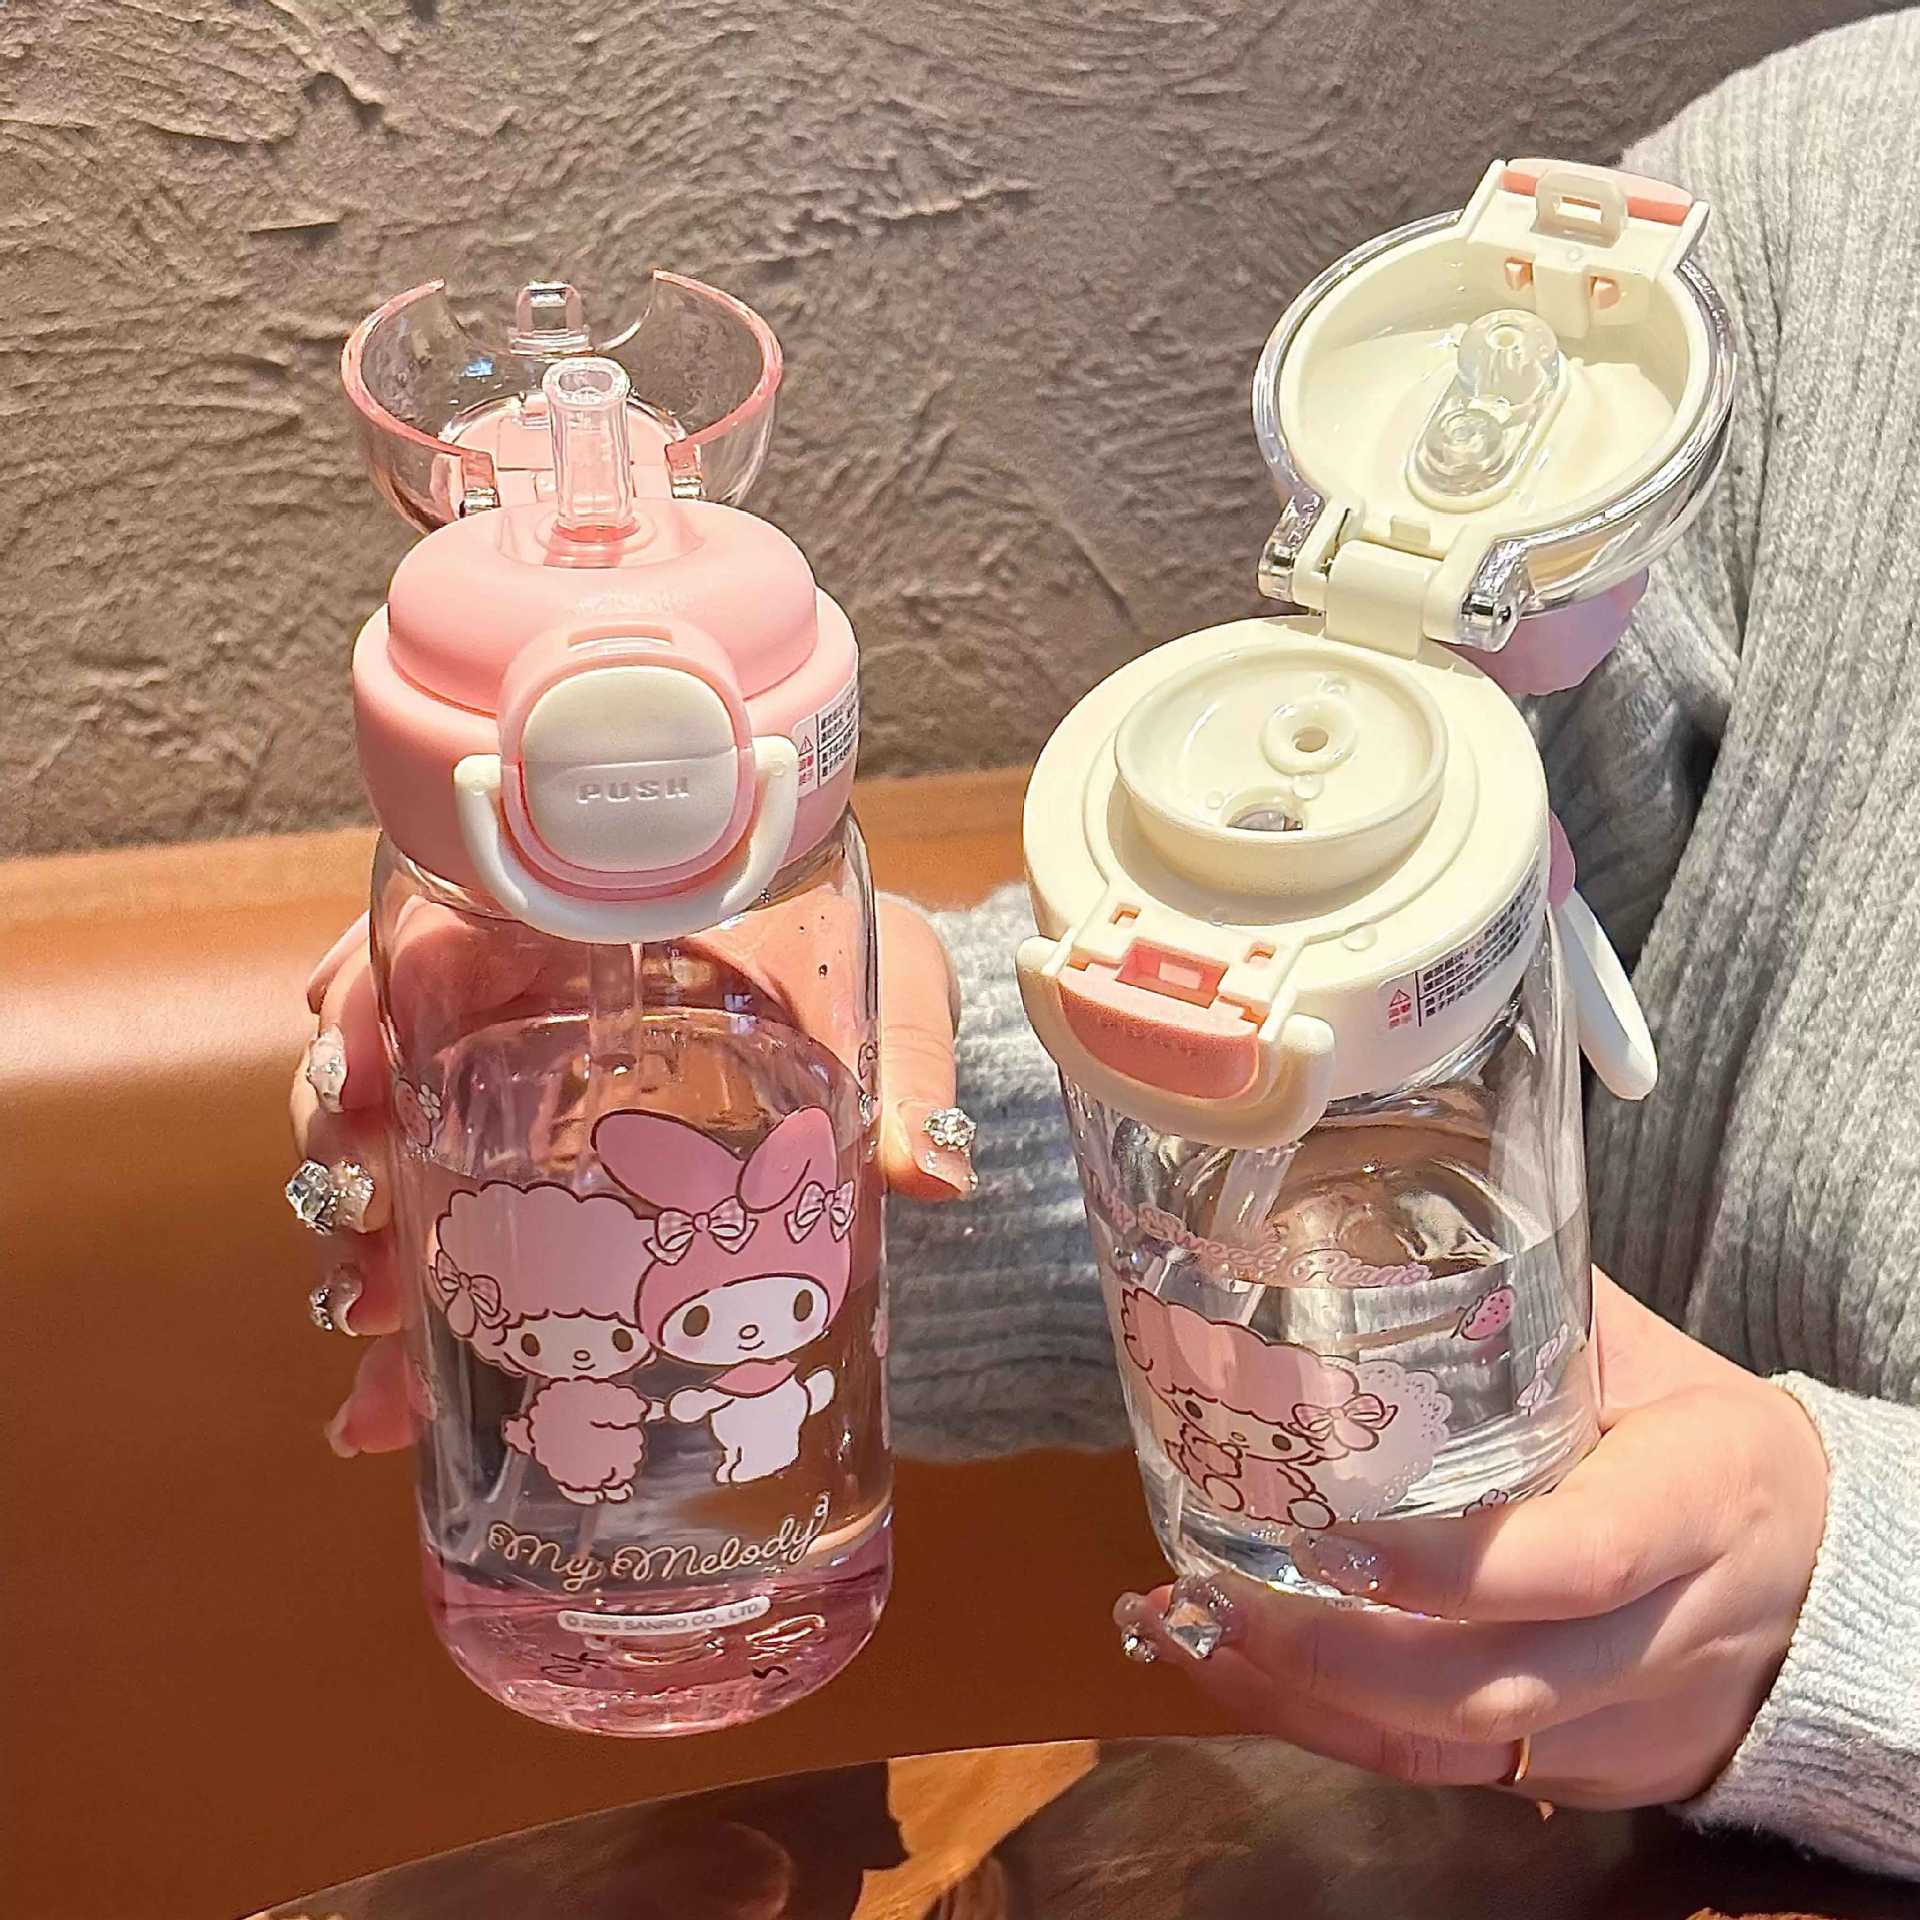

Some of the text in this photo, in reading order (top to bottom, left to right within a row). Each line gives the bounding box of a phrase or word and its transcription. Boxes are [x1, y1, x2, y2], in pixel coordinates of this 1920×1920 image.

[576, 777, 690, 804] PUSH
[1291, 1248, 1432, 1290] Piano
[488, 1491, 831, 1592] My Melody
[623, 1618, 688, 1631] SANRIO
